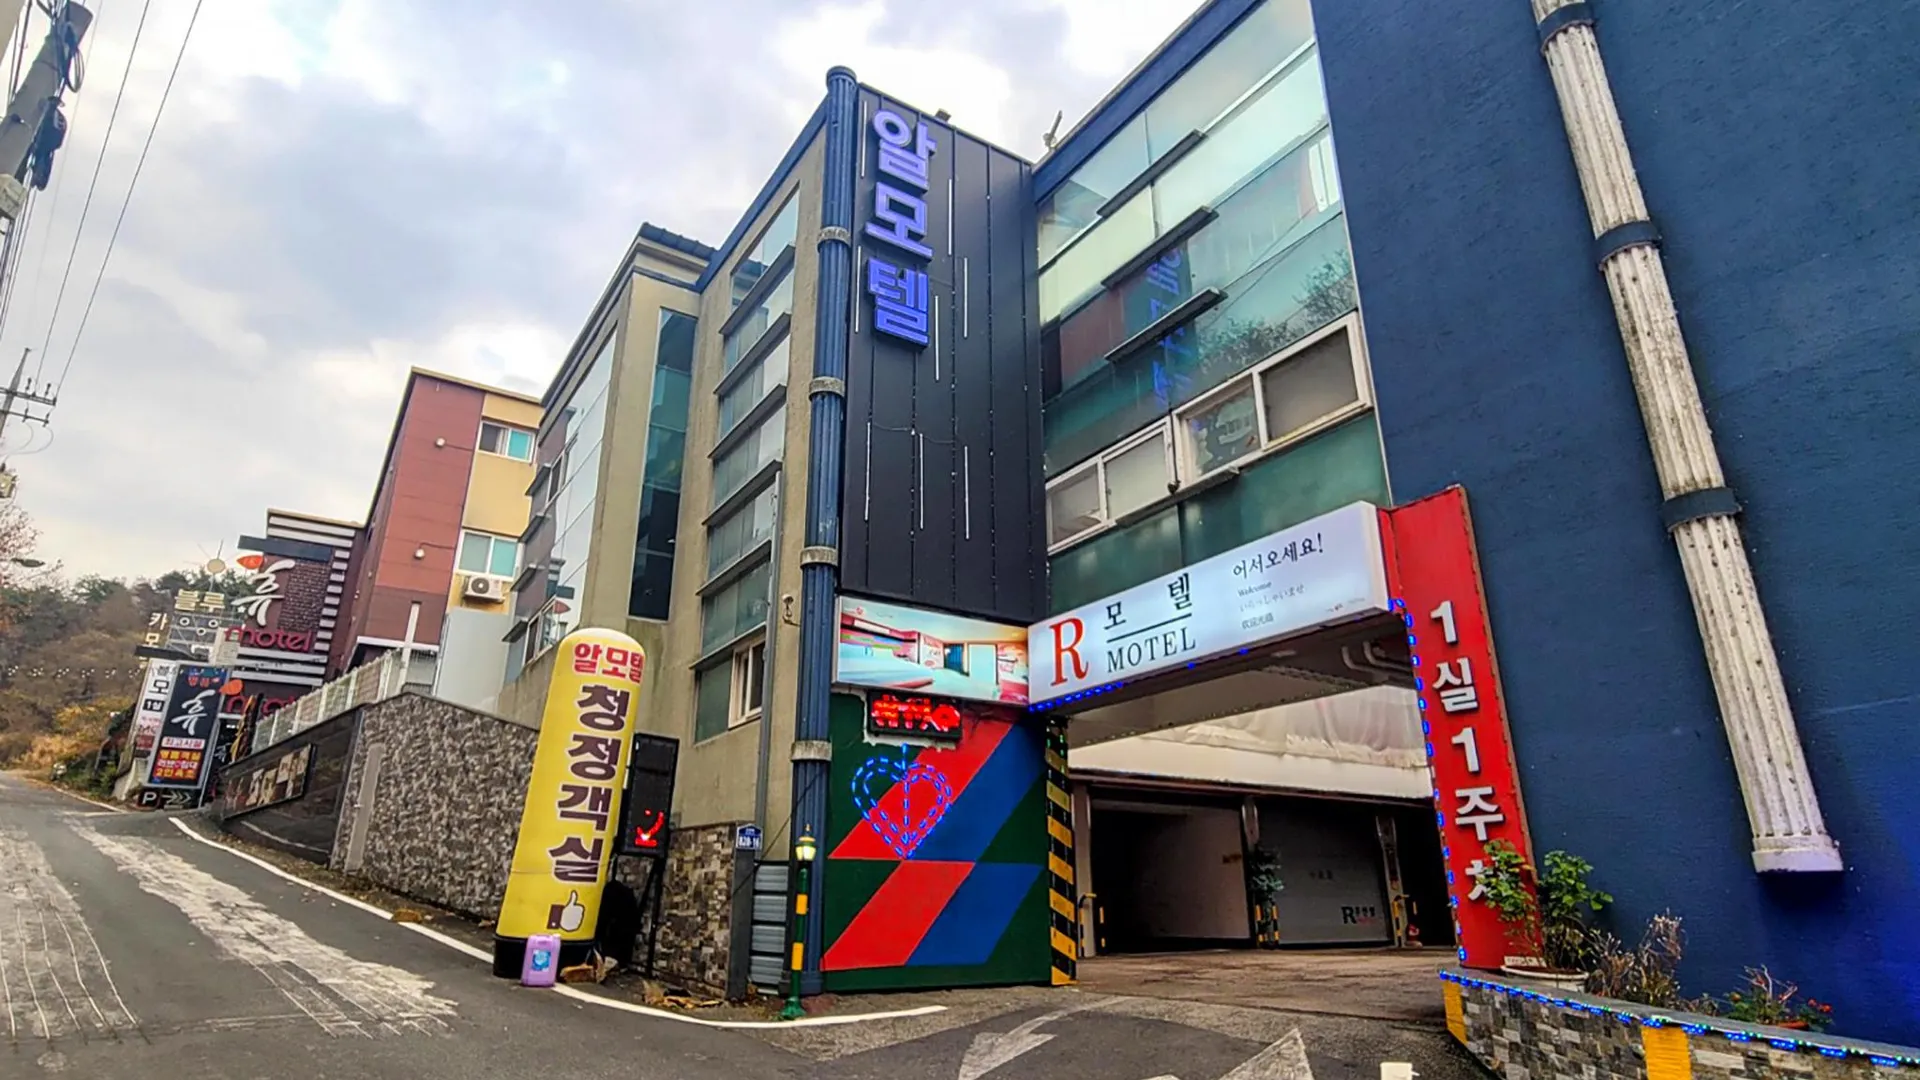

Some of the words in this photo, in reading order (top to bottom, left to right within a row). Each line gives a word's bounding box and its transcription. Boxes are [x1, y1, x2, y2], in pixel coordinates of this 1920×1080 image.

[864, 108, 938, 346] 알모텔
[1233, 532, 1324, 580] 어서오세요!
[225, 624, 312, 651] motel
[1049, 616, 1090, 687] R
[1106, 625, 1197, 674] MOTEL
[573, 643, 645, 684] 알모텔
[142, 791, 157, 805] P
[548, 683, 632, 884] 청정객실
